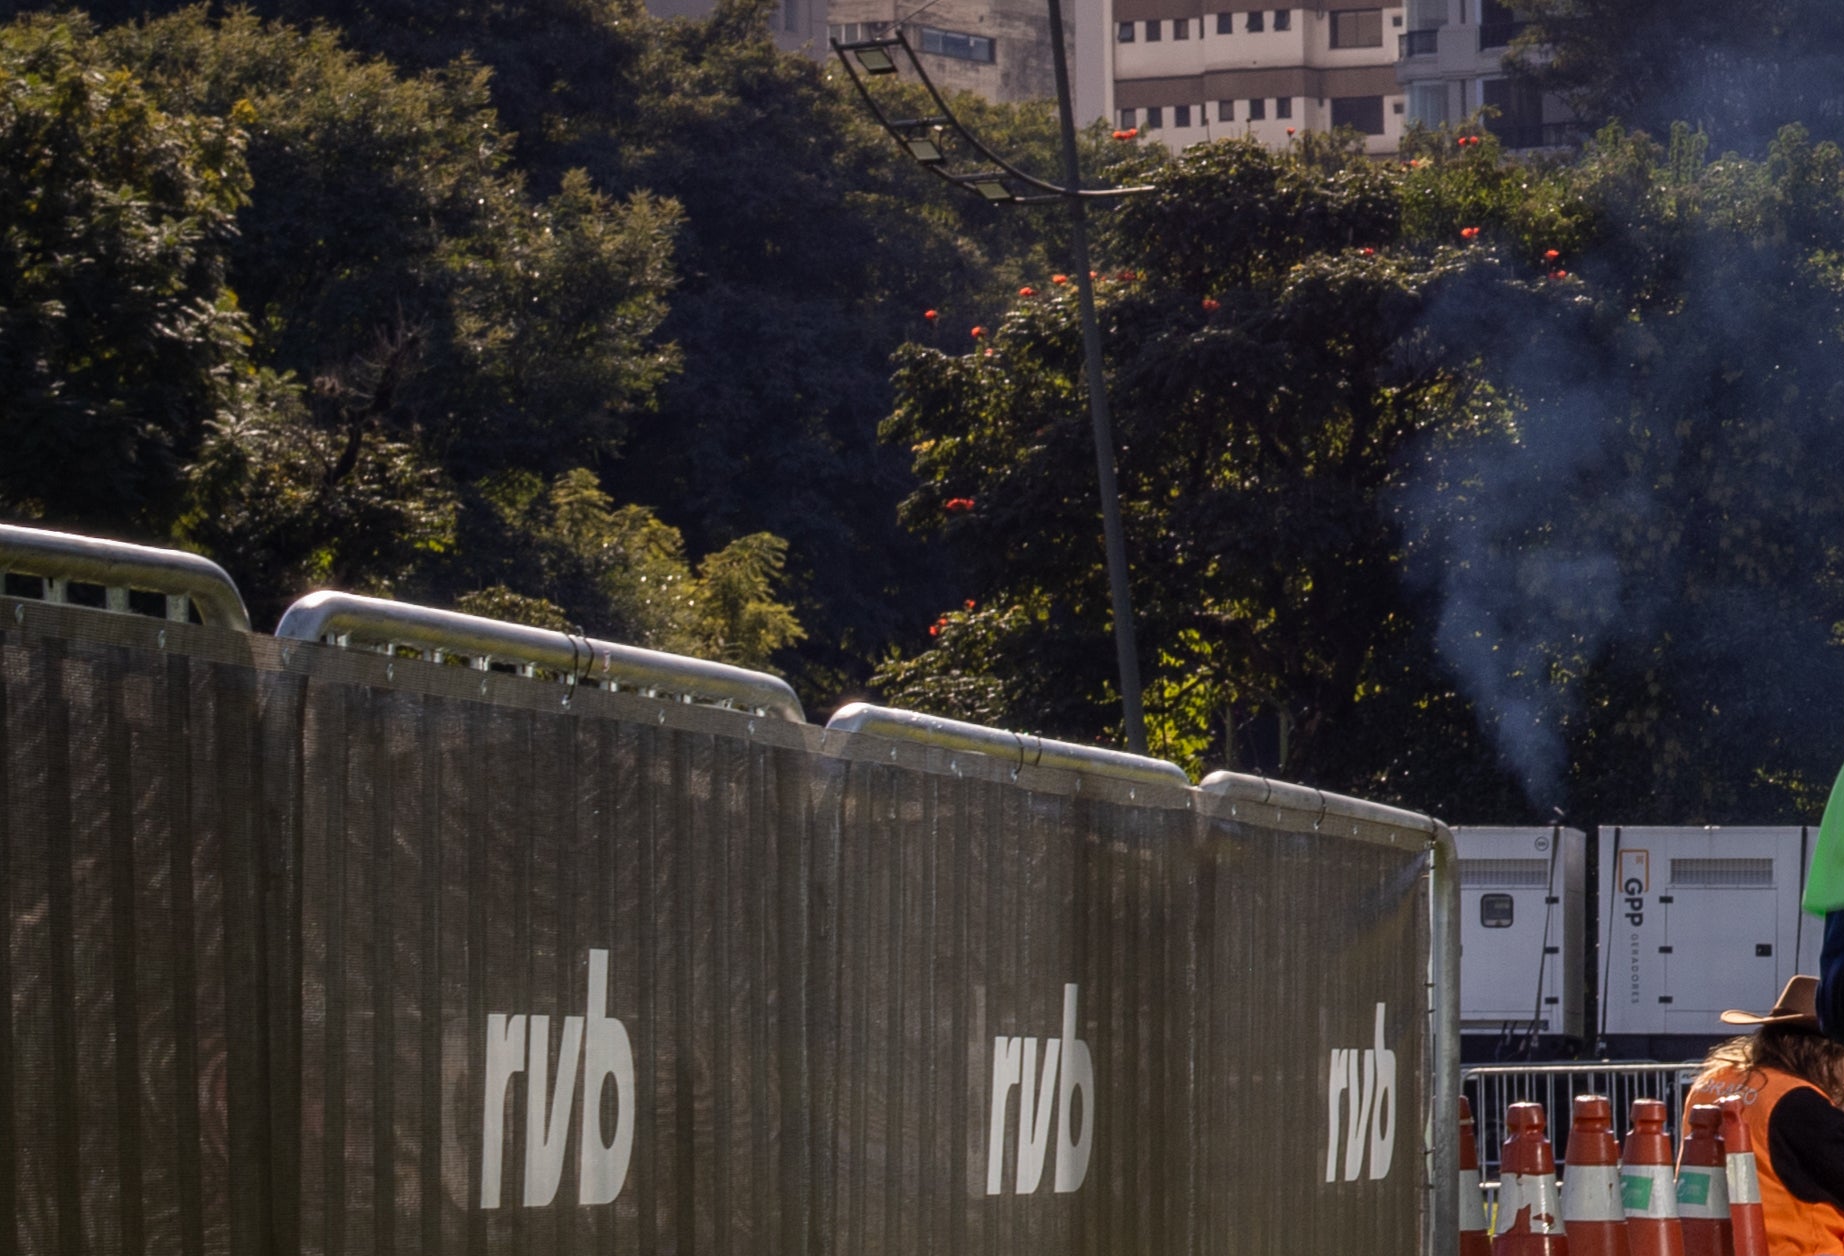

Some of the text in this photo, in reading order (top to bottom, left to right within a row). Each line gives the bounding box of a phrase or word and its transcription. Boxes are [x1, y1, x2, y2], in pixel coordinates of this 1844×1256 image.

[1624, 877, 1644, 927] GPP
[480, 949, 636, 1210] rvb
[986, 983, 1096, 1196] rvb
[1325, 1002, 1397, 1183] rvb
